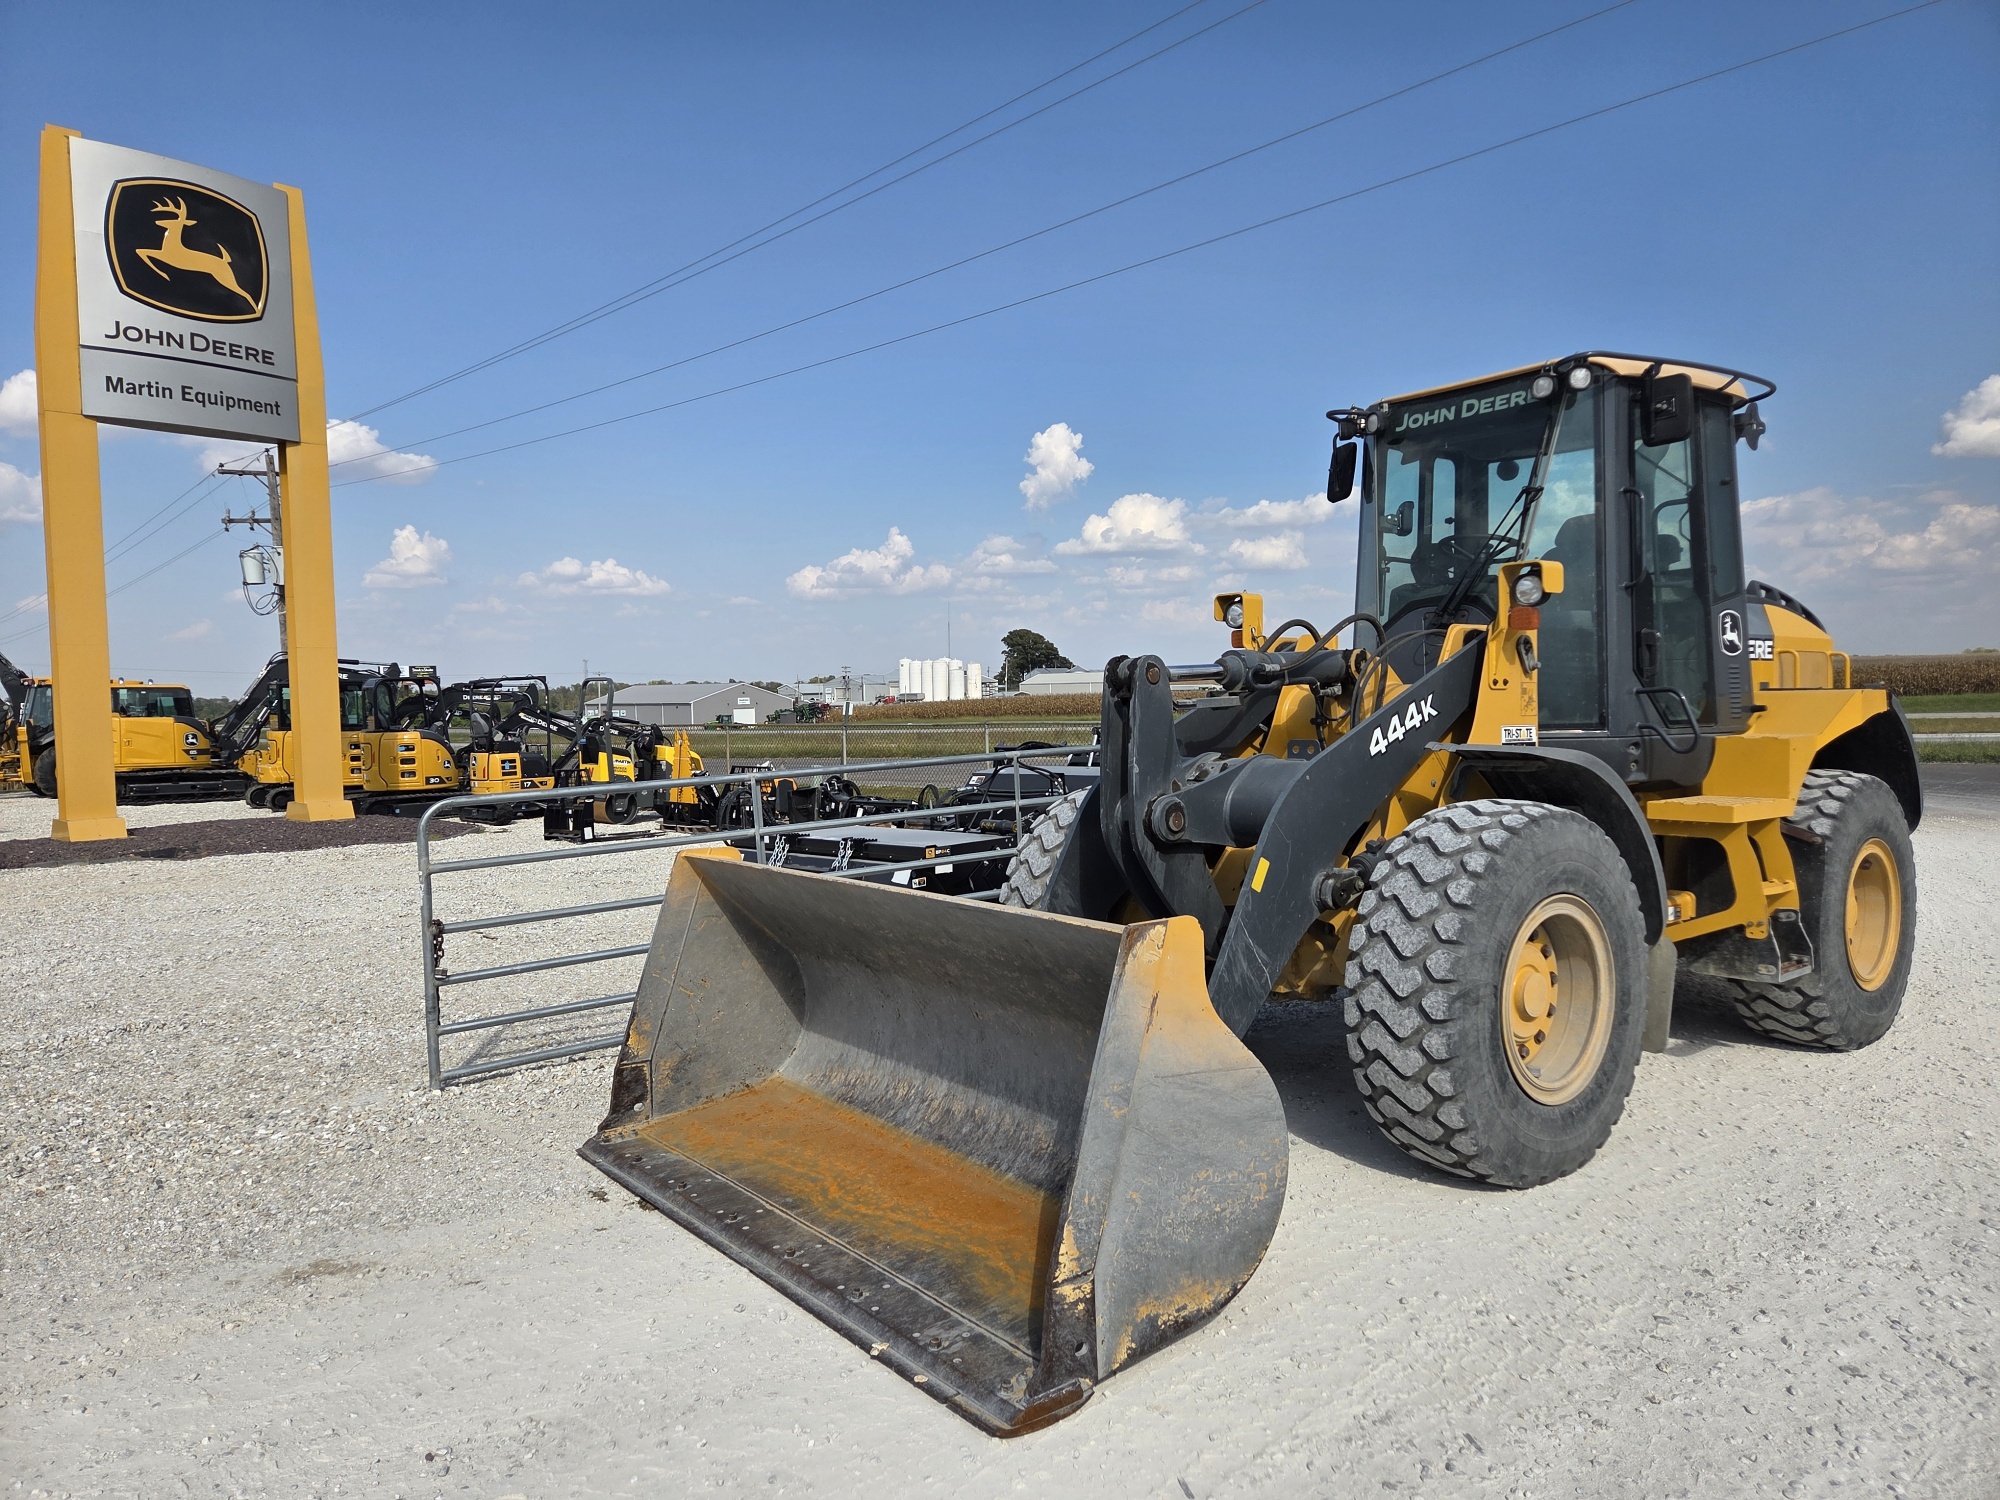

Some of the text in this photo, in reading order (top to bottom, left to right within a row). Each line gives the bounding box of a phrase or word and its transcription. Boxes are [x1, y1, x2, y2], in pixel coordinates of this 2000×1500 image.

[104, 320, 275, 366] JOHN DEERE
[105, 375, 281, 416] Martin Equipment
[1395, 405, 1456, 432] JOHN
[1369, 693, 1438, 757] 444K
